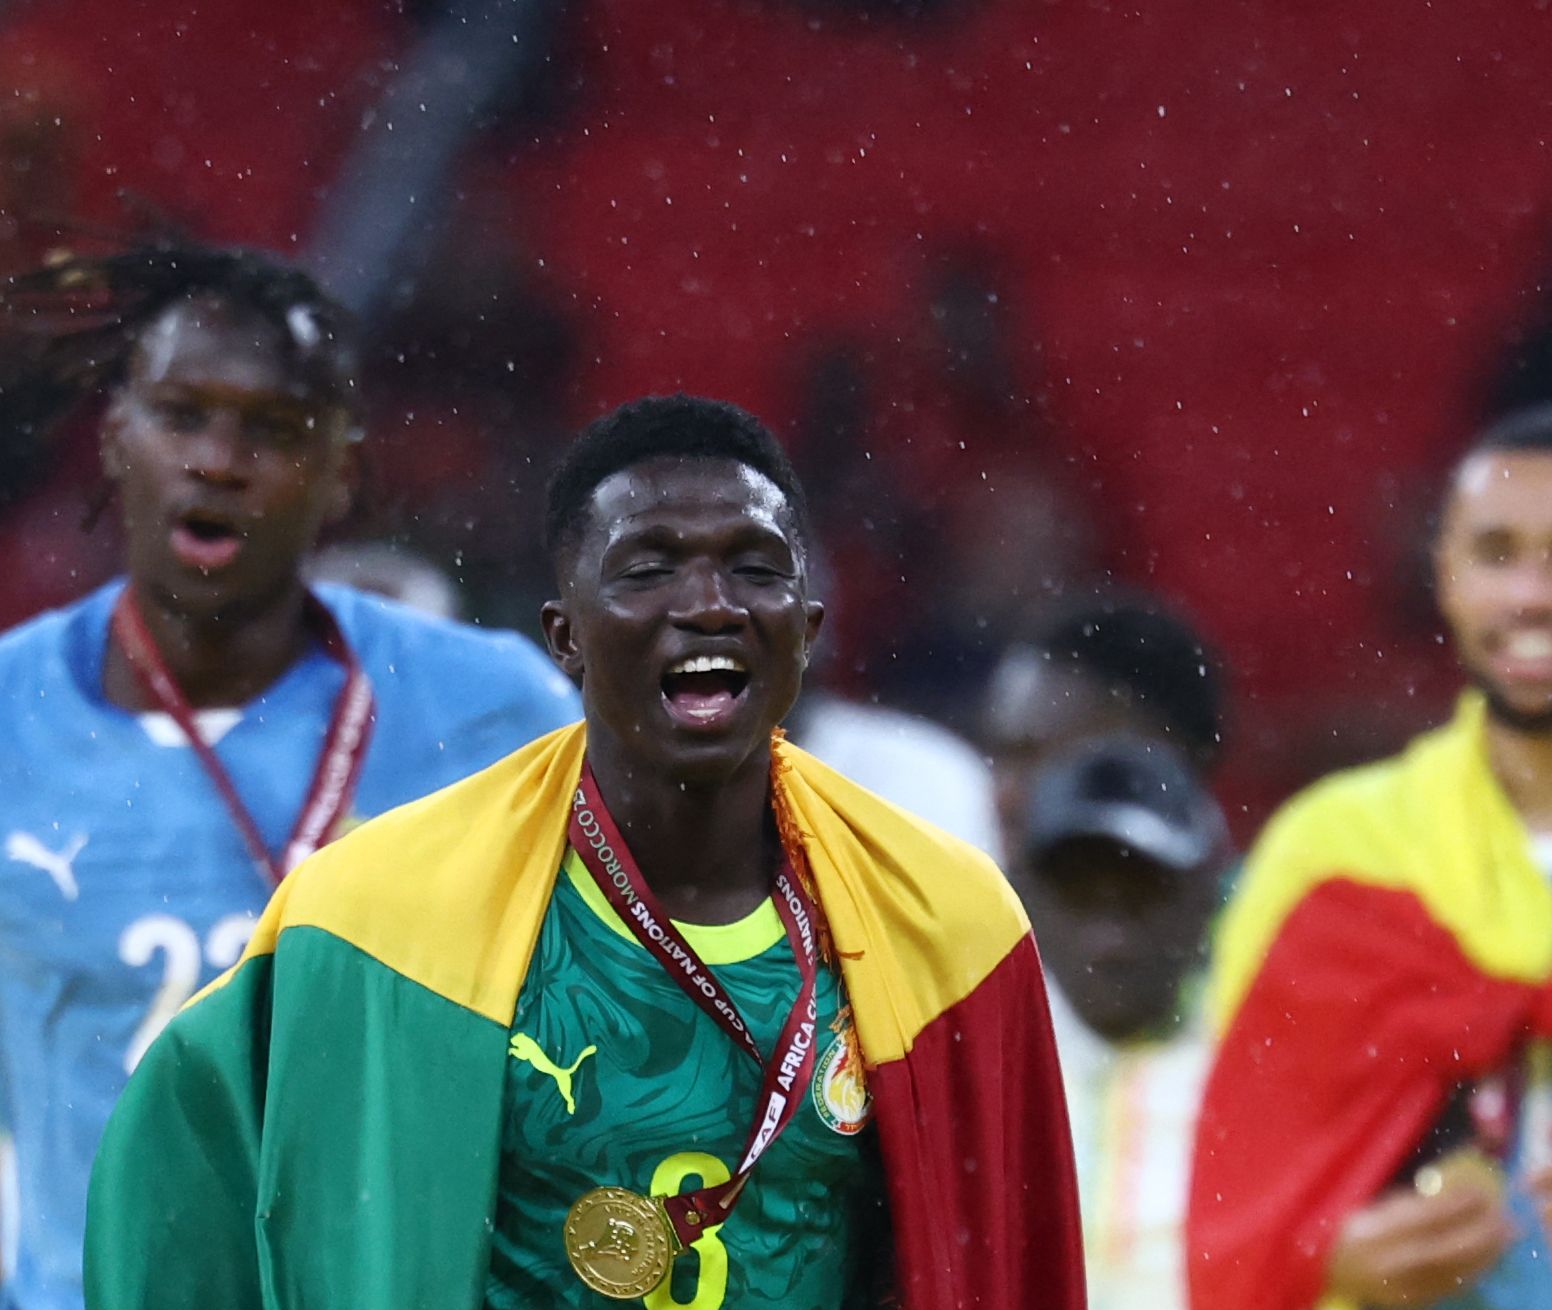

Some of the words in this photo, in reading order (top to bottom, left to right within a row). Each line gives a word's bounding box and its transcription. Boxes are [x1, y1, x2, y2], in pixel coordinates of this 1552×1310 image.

[578, 810, 638, 905] MOROCCO
[631, 901, 697, 975] NATIONS
[776, 875, 814, 955] NATIONS
[692, 973, 716, 998] OF
[714, 999, 744, 1032] CUP
[777, 1021, 815, 1092] AFRICA
[749, 1104, 782, 1160] CAF
